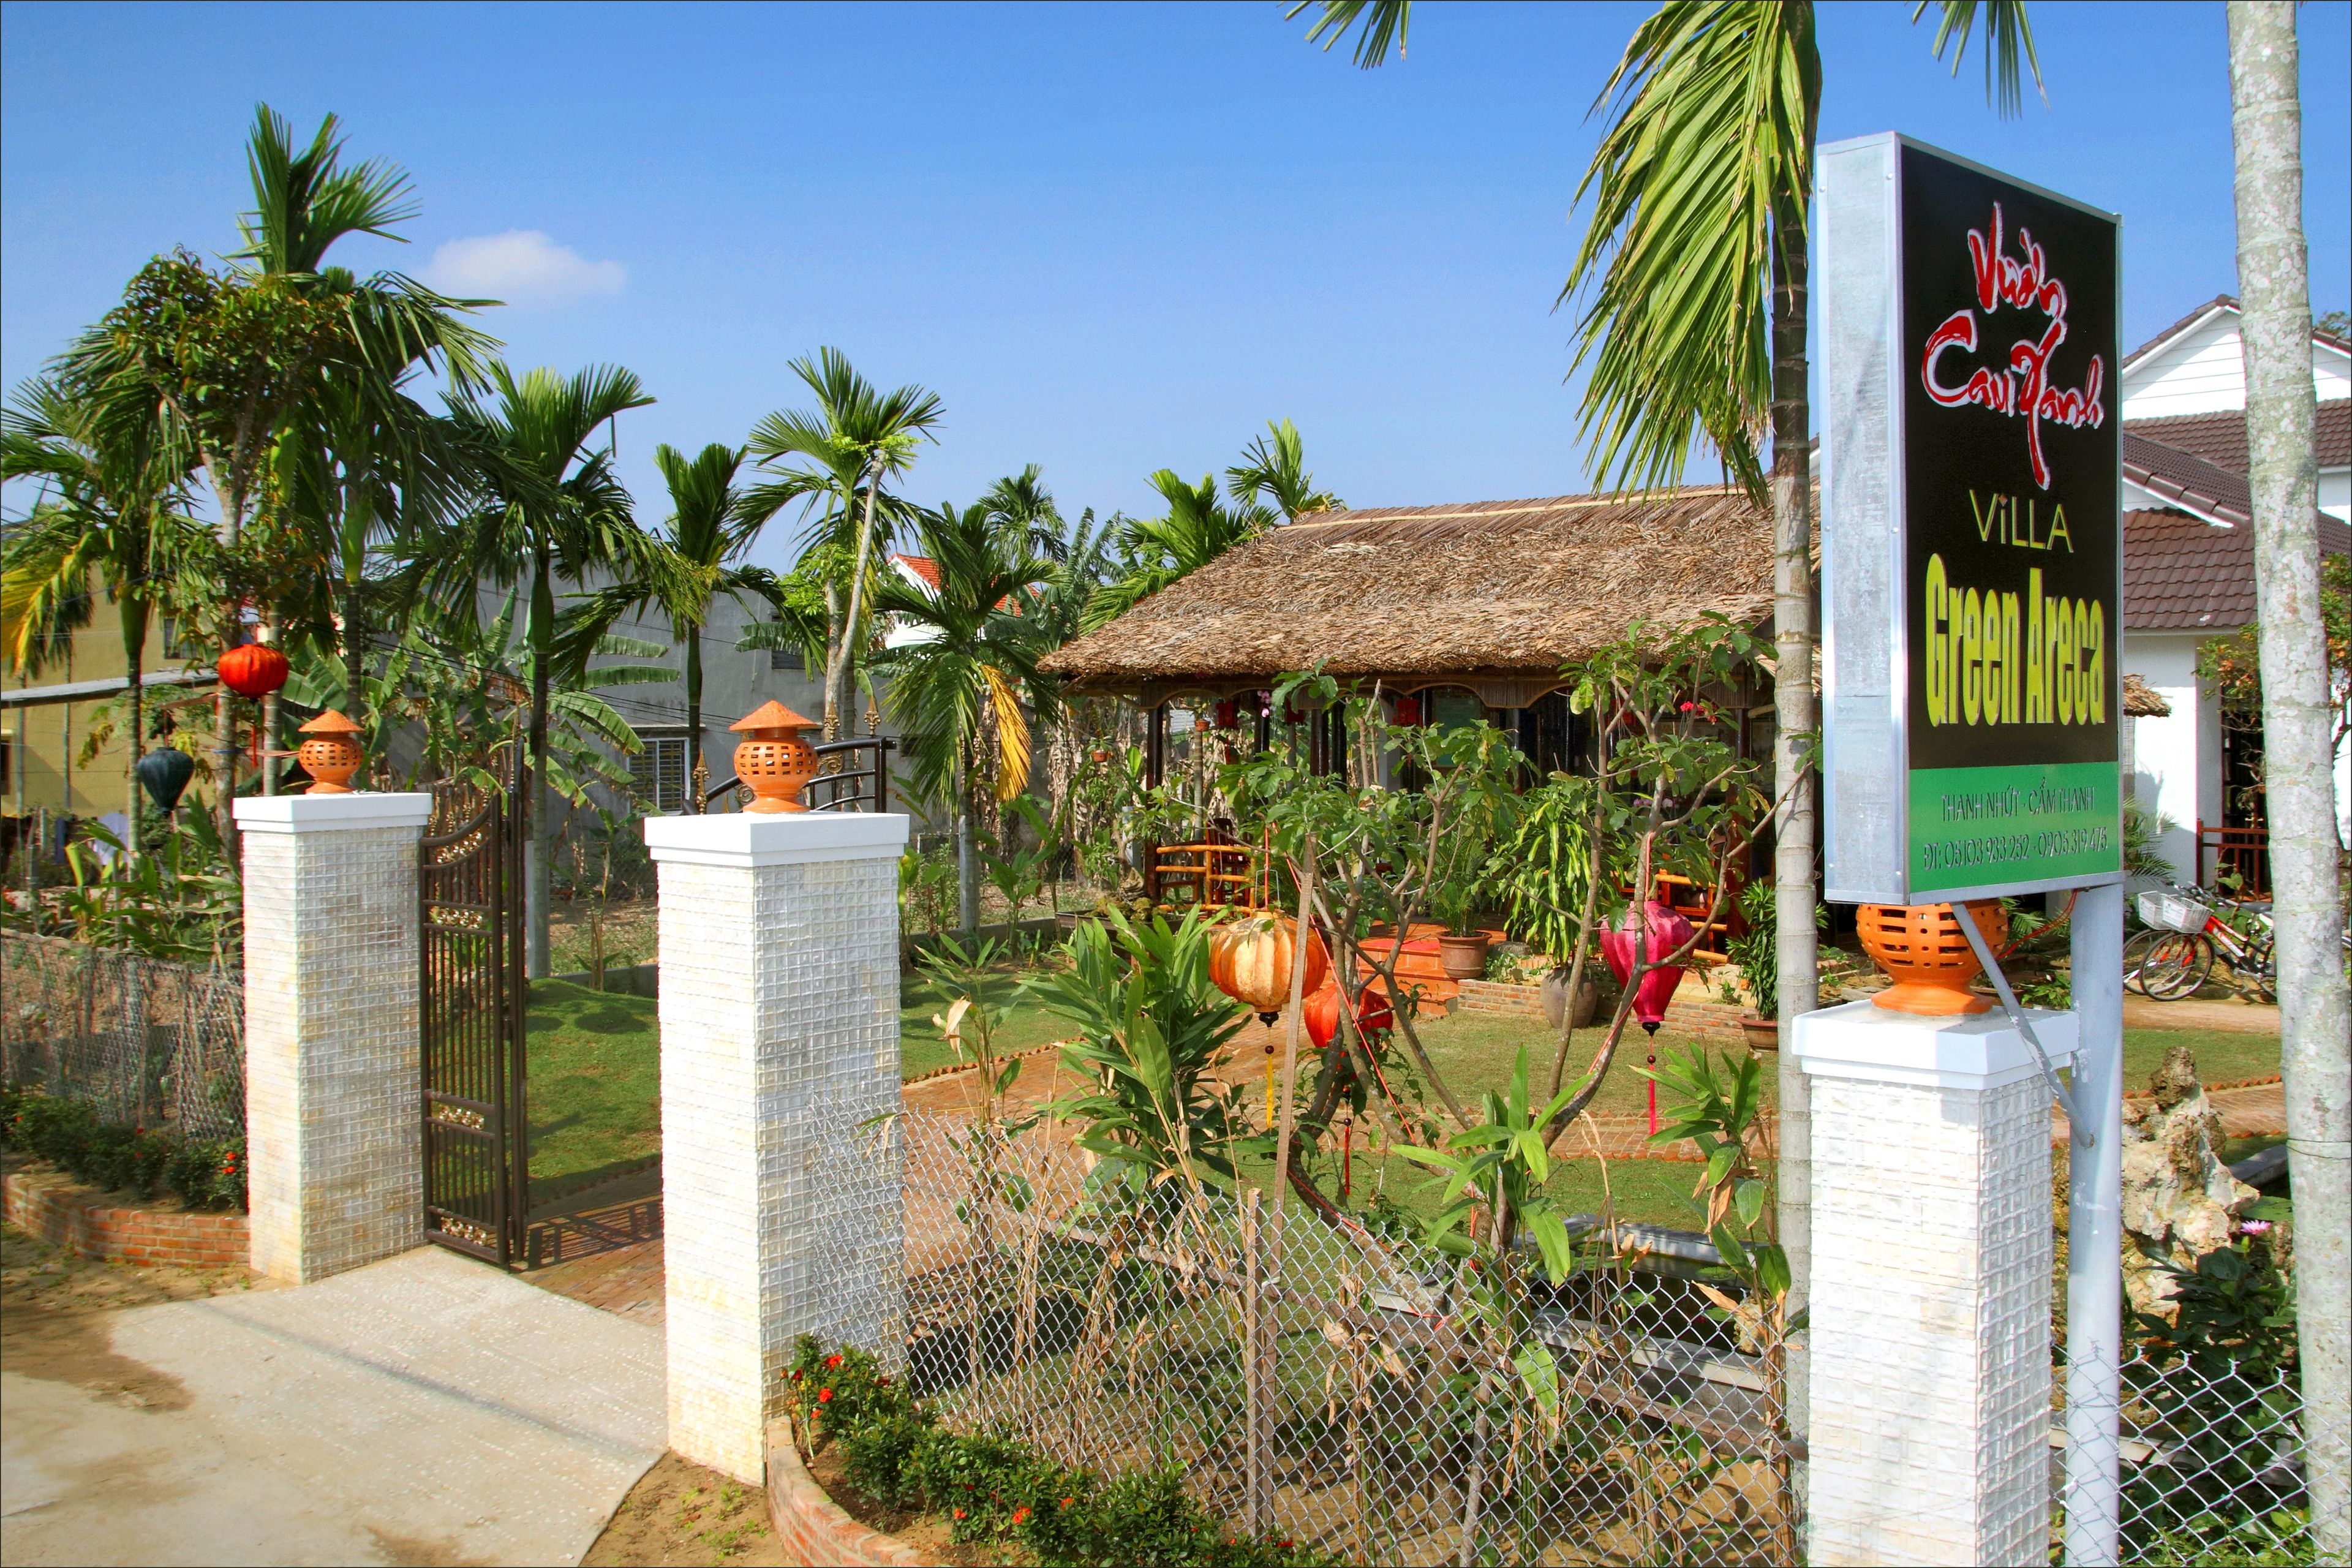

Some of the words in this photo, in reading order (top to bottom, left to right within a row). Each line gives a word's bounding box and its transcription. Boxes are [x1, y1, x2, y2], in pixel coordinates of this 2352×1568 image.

[1921, 309, 2016, 418] Cau
[1925, 552, 2020, 727] Green
[2026, 567, 2105, 726] Areca
[1942, 793, 1983, 822] THANH
[2059, 786, 2095, 813] THANH
[1924, 843, 1942, 871] ĐT:
[1945, 838, 1983, 868] 05103
[1986, 837, 2007, 864] 933
[2009, 833, 2029, 861] 252
[2038, 831, 2070, 858] 0905
[2071, 828, 2088, 854] 319
[2089, 826, 2108, 852] 475
